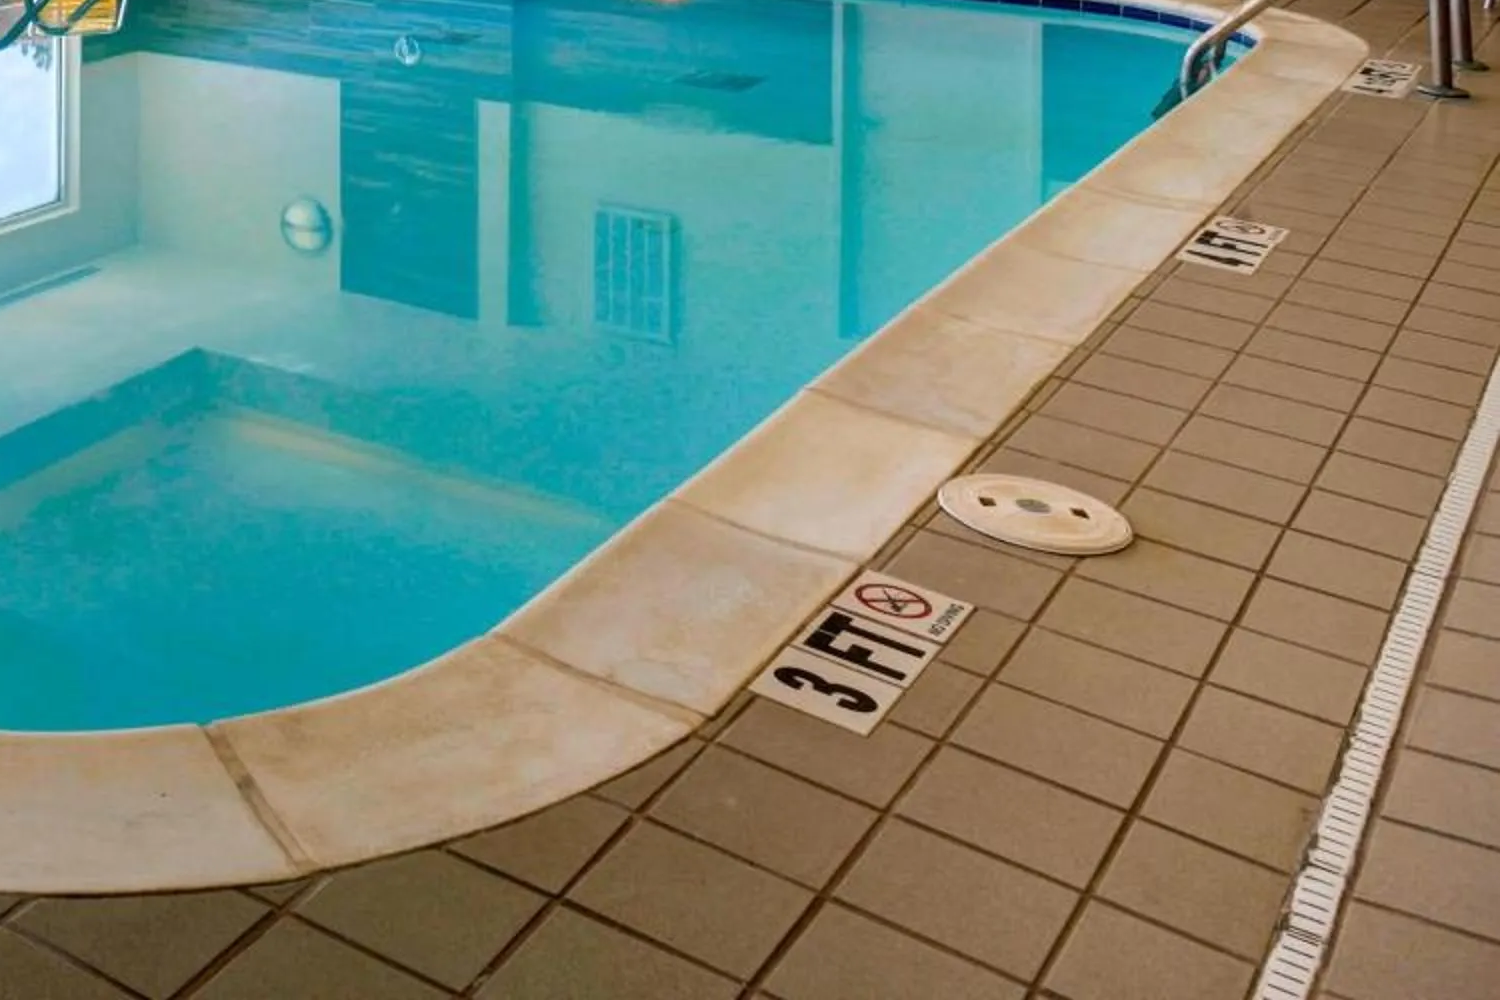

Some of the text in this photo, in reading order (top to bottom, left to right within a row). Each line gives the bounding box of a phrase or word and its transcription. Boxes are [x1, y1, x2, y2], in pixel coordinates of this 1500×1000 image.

[1196, 230, 1269, 256] FT
[773, 611, 926, 713] 3 FT
